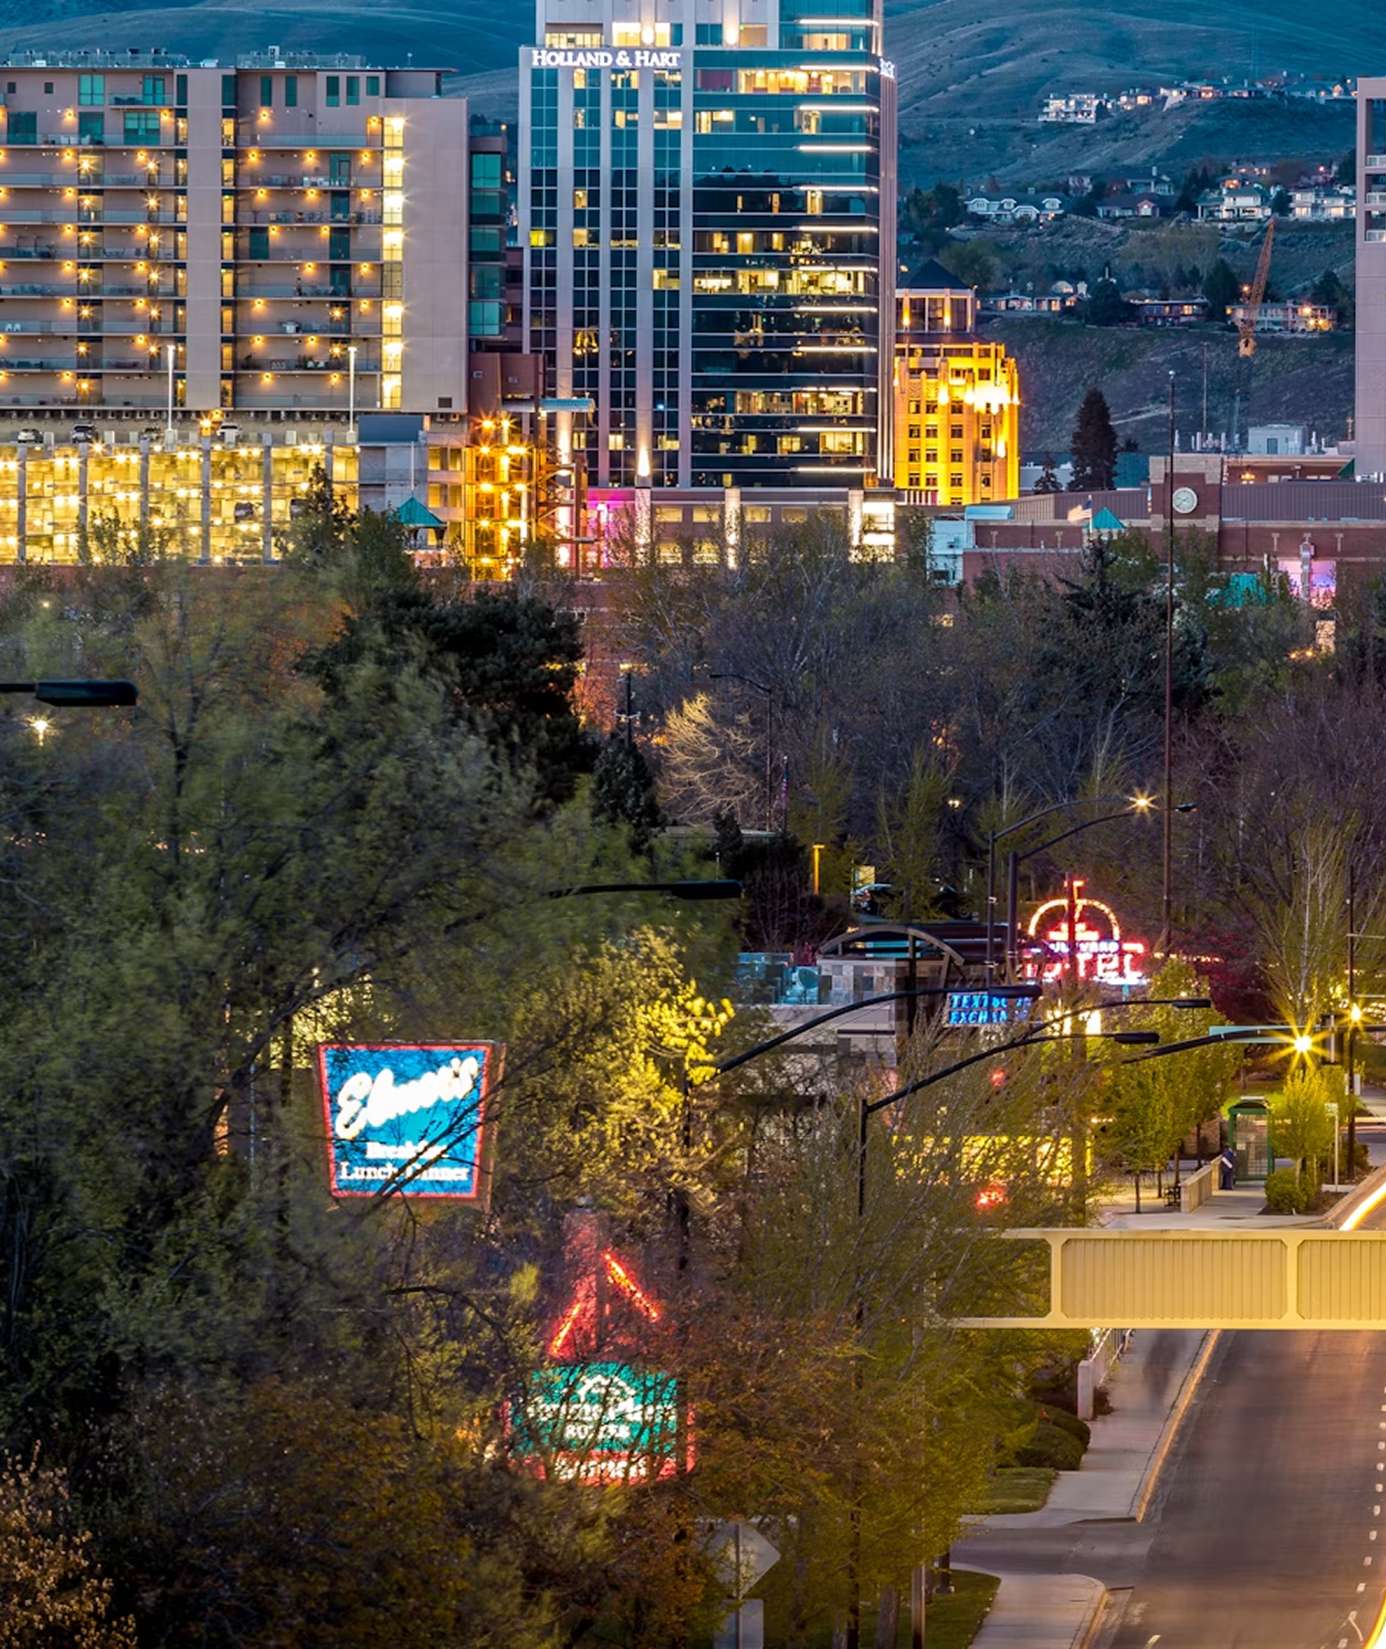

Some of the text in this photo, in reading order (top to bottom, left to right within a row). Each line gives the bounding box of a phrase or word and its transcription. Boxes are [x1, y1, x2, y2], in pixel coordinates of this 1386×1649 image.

[532, 51, 680, 66] HOLLAND & HART
